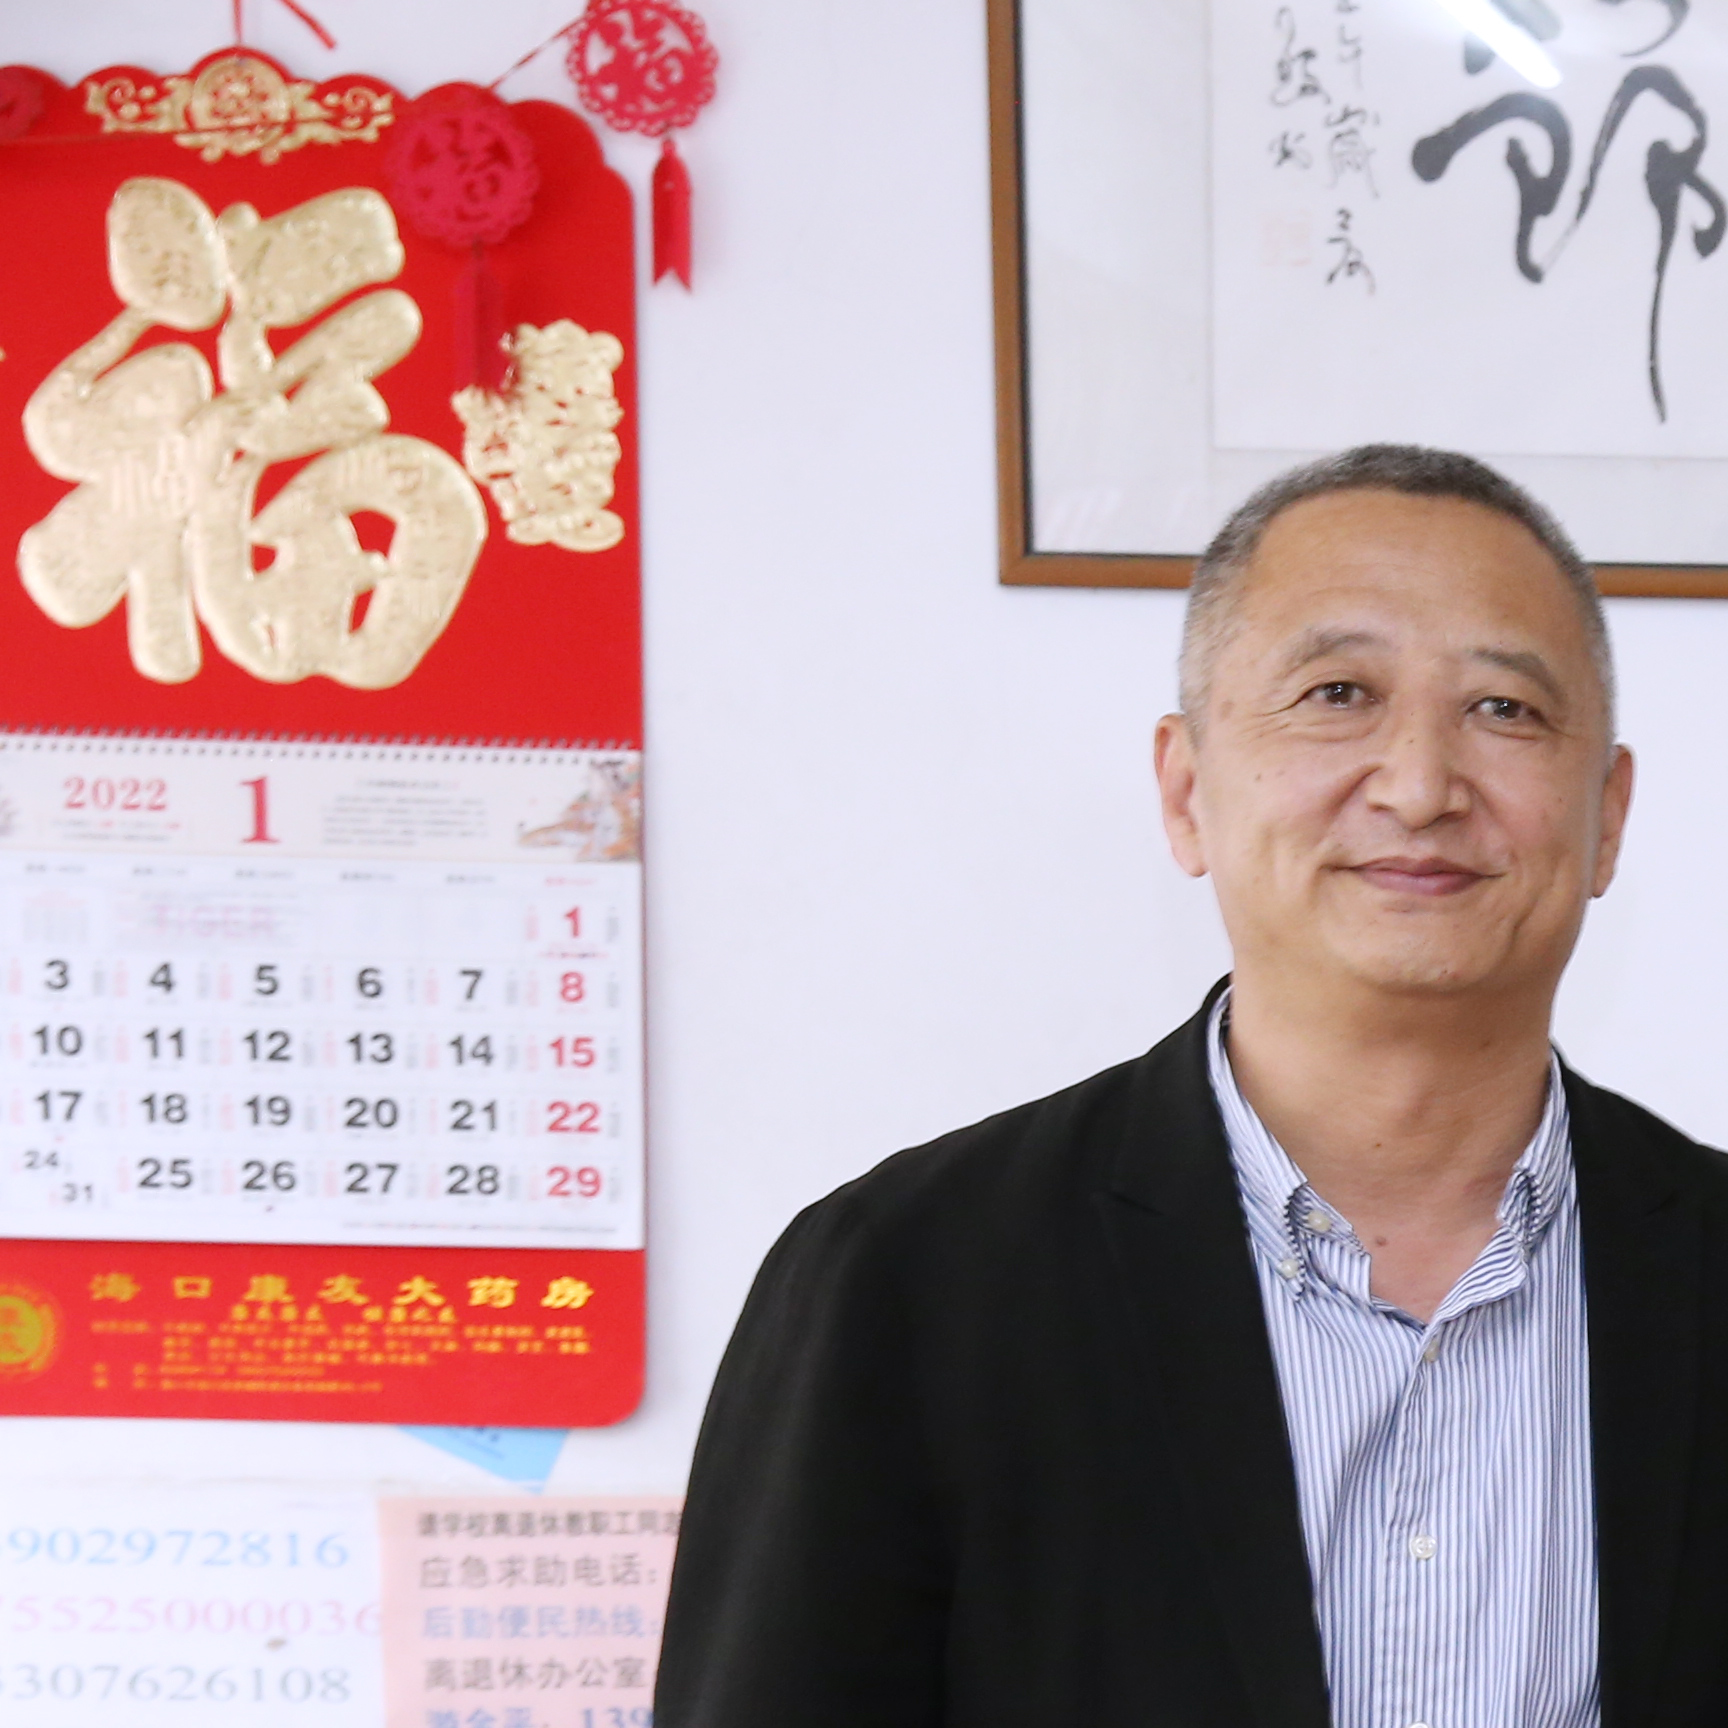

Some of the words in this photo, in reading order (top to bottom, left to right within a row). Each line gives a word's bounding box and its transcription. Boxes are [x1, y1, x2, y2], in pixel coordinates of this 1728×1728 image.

[17, 176, 487, 690] 福
[64, 775, 168, 811] 2022
[241, 775, 281, 845] 1
[564, 906, 580, 938] 1
[46, 958, 70, 991] 3
[149, 962, 175, 993] 4
[255, 963, 280, 997] 5
[356, 966, 384, 1000] 6
[460, 968, 483, 1001] 7
[559, 971, 585, 1004] 8
[34, 1025, 83, 1057] 10
[143, 1028, 184, 1059] 11
[243, 1029, 291, 1063] 12
[347, 1032, 395, 1065] 13
[449, 1034, 494, 1066] 14
[549, 1036, 596, 1069] 15
[36, 1090, 83, 1121] 17
[141, 1092, 188, 1125] 18
[245, 1094, 292, 1127] 19
[344, 1096, 399, 1130] 20
[450, 1099, 498, 1132] 21
[546, 1100, 600, 1134] 22
[25, 1151, 59, 1170] 24
[138, 1157, 193, 1190] 25
[242, 1159, 297, 1192] 26
[345, 1161, 399, 1194] 27
[446, 1163, 500, 1196] 28
[547, 1165, 602, 1199] 29
[0, 1526, 351, 1568] 902972816
[0, 1596, 382, 1637] 5525000036
[0, 1663, 351, 1703] 307626108
